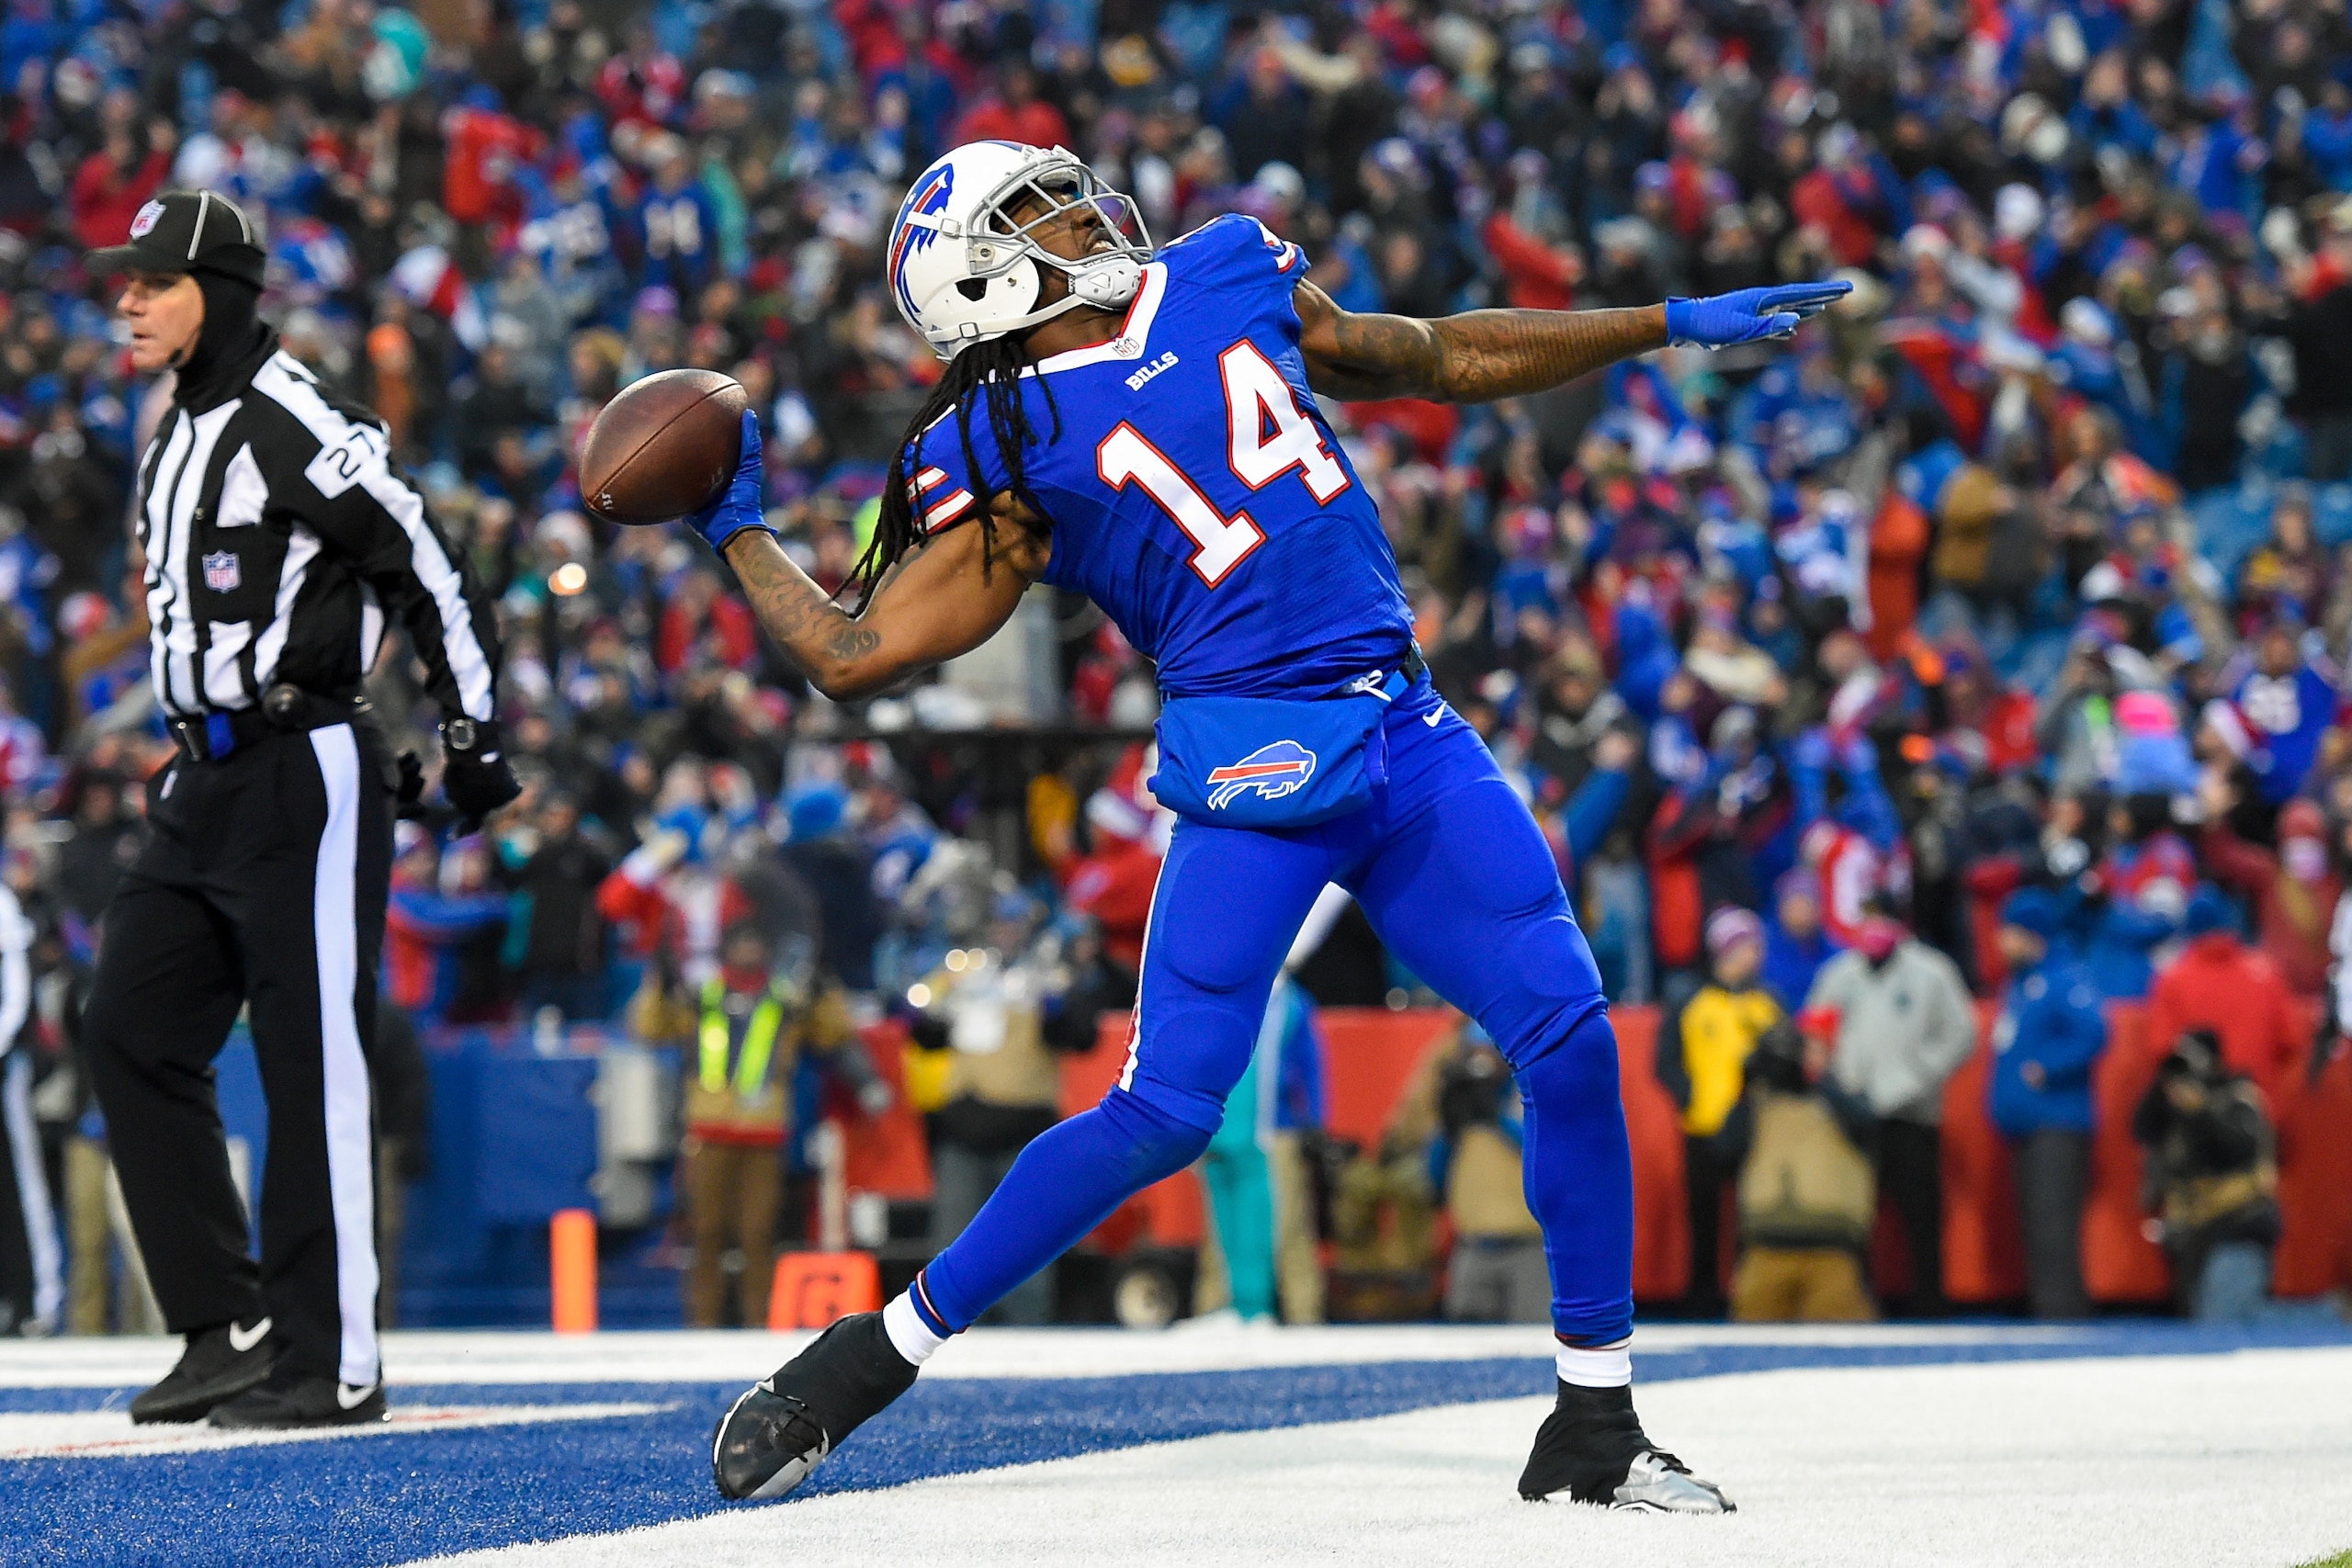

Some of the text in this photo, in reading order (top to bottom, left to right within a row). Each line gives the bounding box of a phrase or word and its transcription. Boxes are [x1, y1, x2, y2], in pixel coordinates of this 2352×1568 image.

[1124, 350, 1180, 392] BILLS
[326, 431, 375, 479] 27
[1095, 337, 1352, 590] 14
